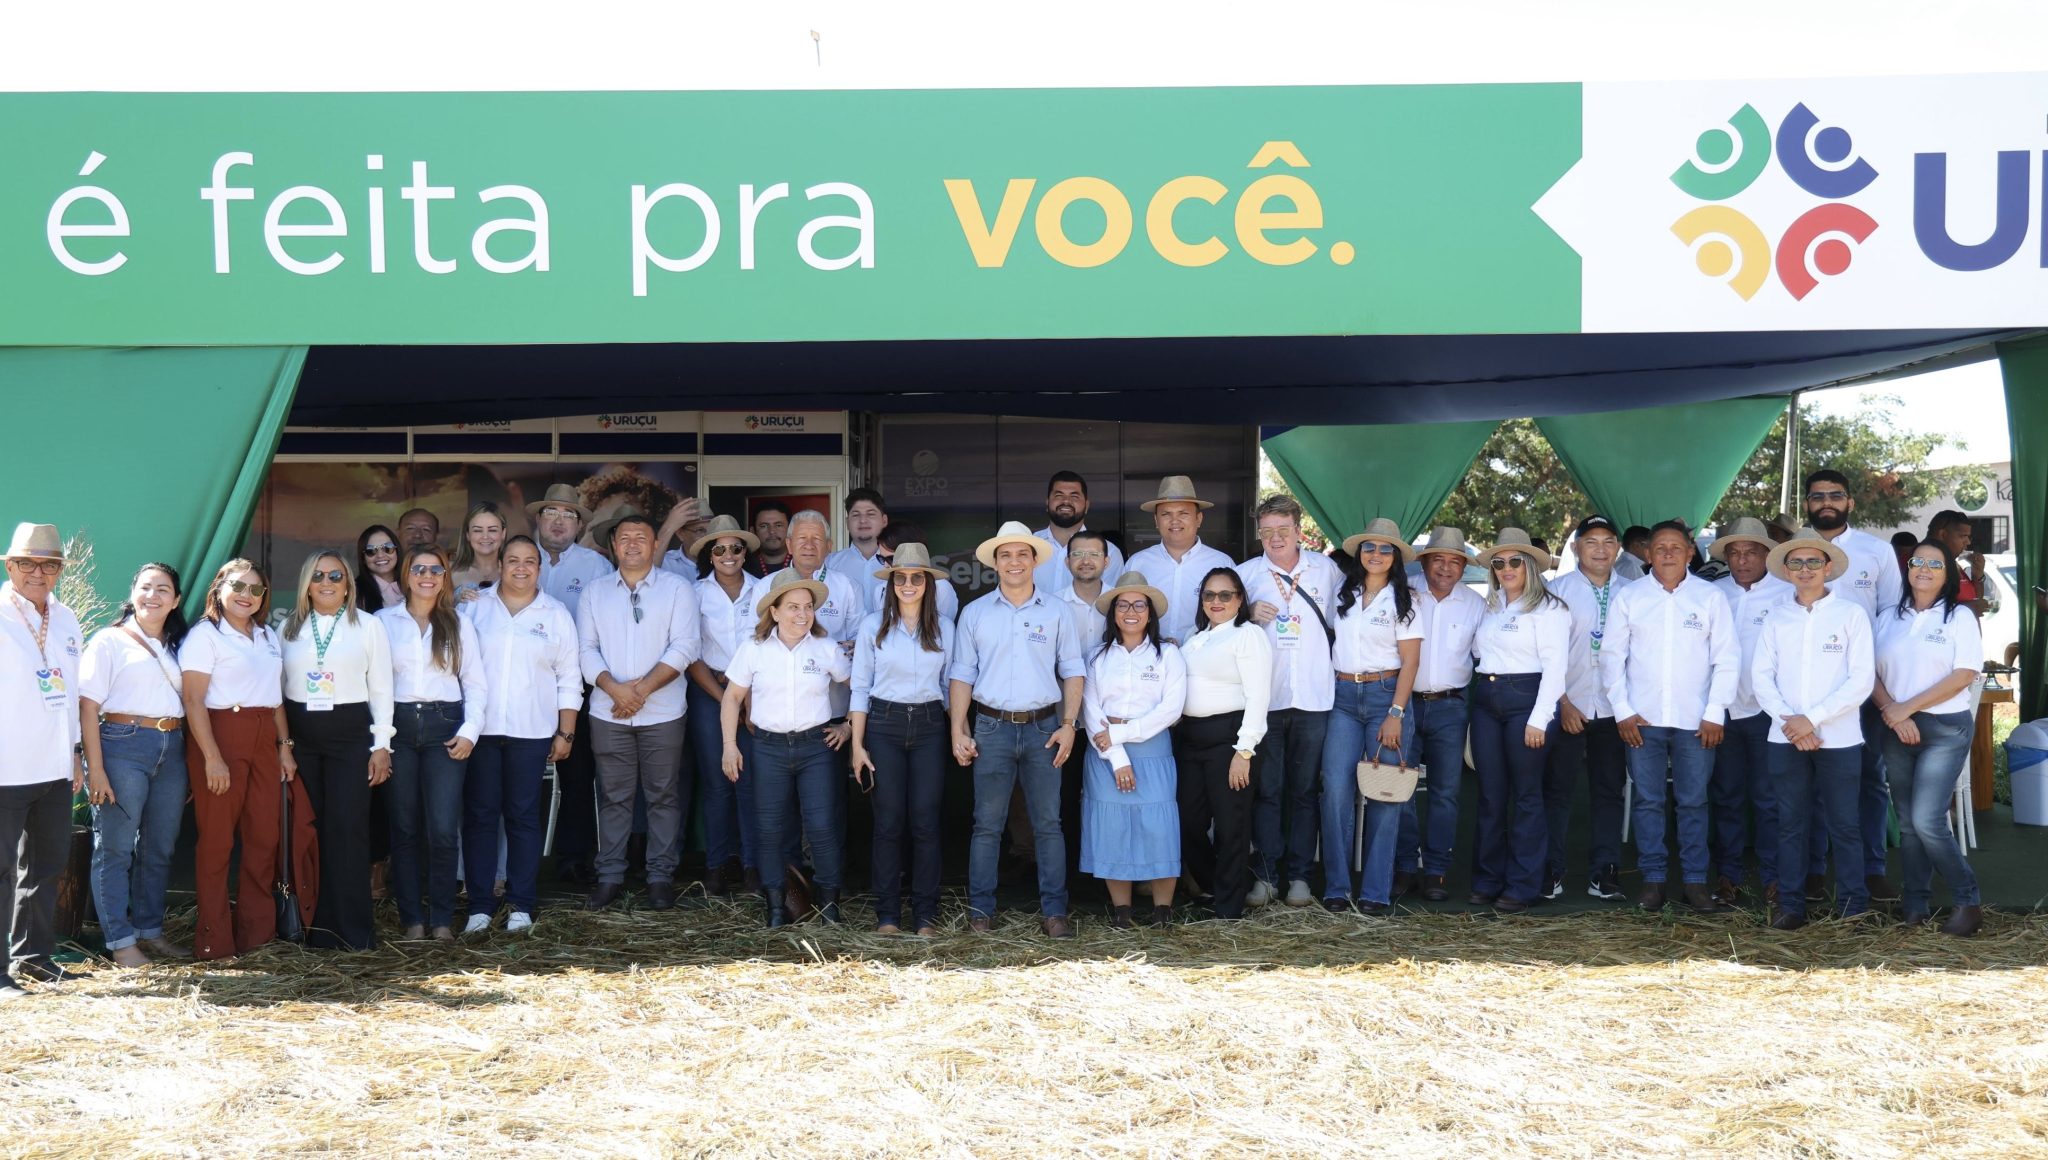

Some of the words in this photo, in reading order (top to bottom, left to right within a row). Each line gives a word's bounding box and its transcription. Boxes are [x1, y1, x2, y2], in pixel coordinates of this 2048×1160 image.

[48, 152, 130, 275] é
[201, 151, 550, 275] feita
[631, 182, 875, 297] pra
[943, 141, 1355, 268] você.
[1913, 149, 2048, 272] U
[905, 477, 949, 489] EXPO
